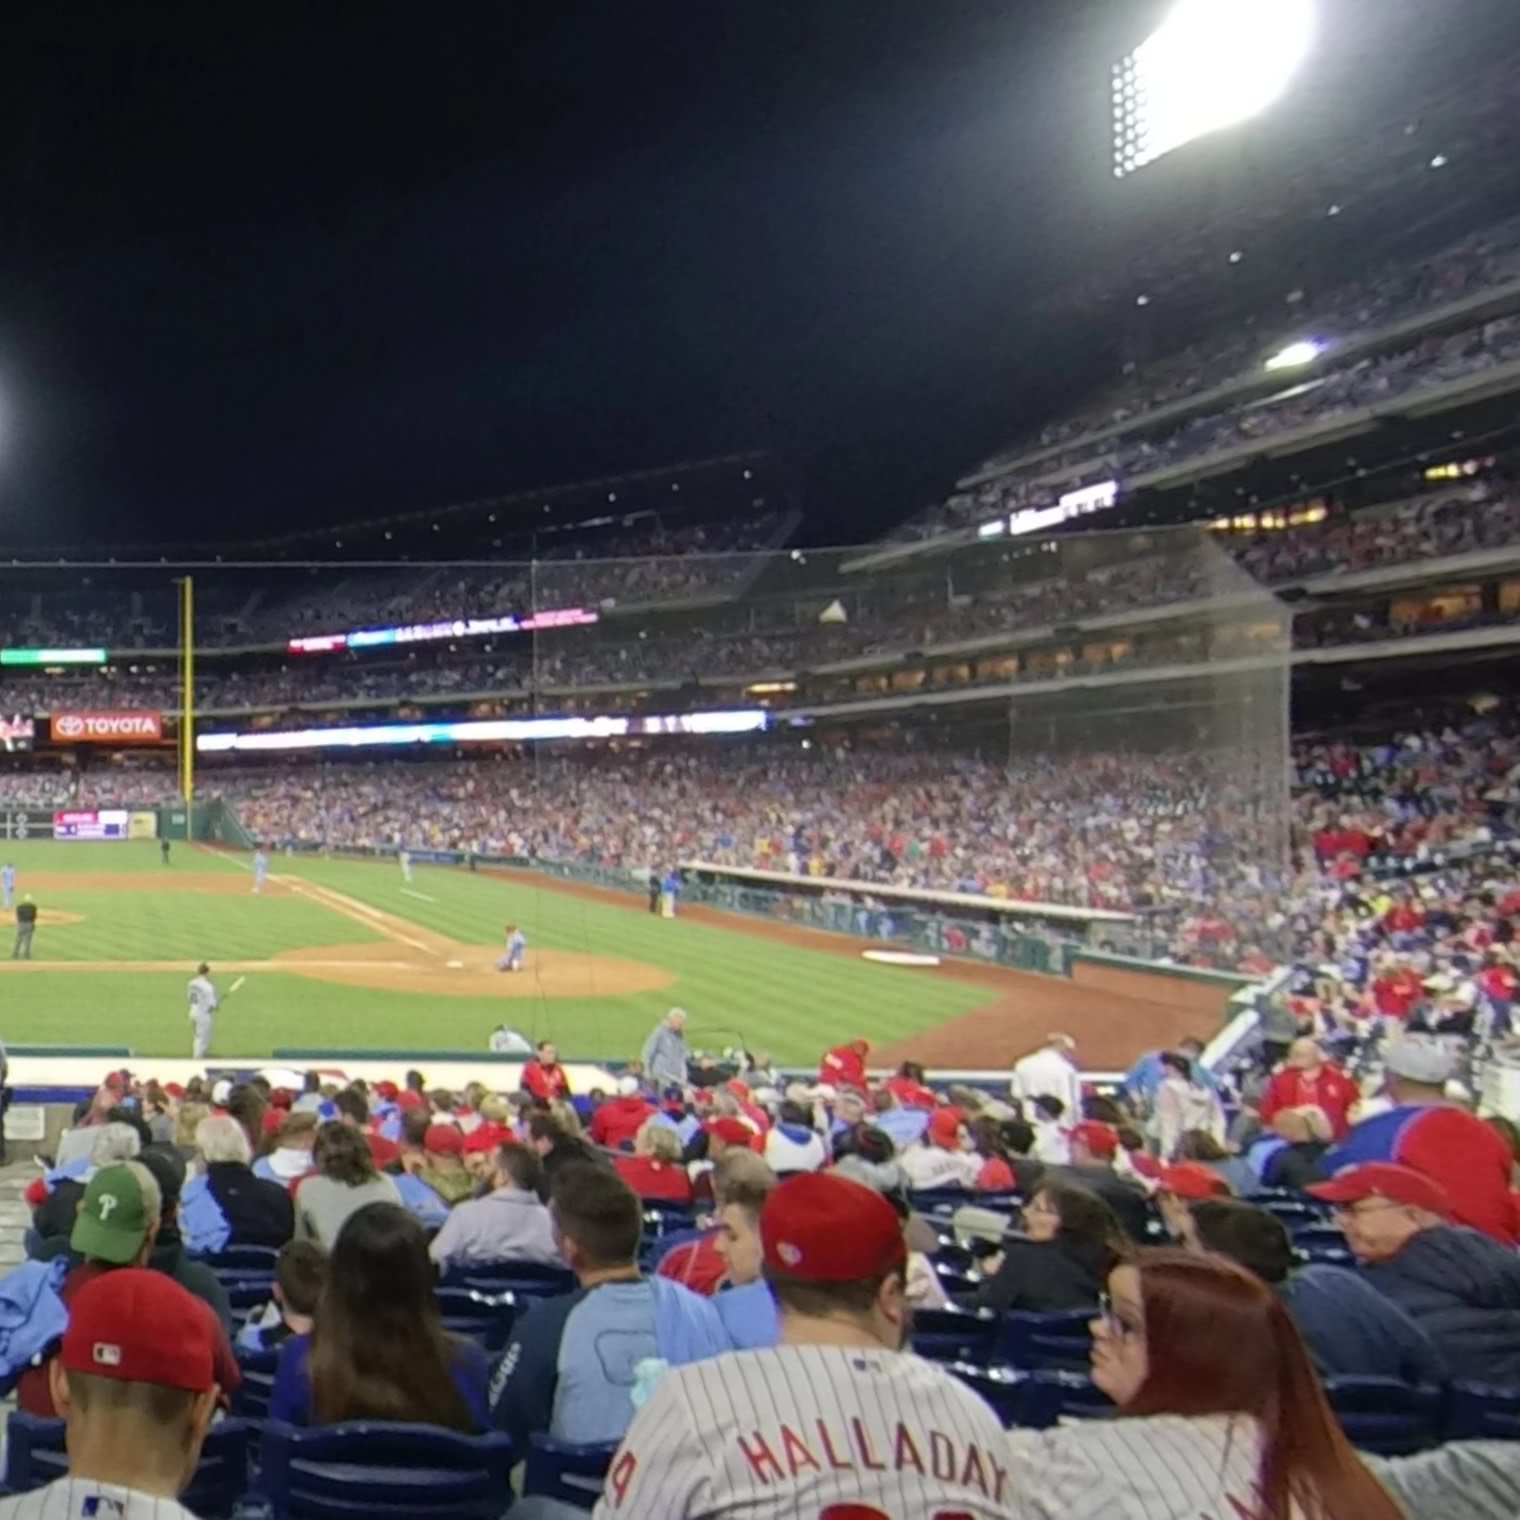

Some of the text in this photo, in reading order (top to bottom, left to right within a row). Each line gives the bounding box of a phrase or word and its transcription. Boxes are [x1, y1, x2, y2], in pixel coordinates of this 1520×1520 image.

[85, 717, 156, 735] TOYOTA
[98, 1193, 118, 1220] P
[736, 1415, 1010, 1504] HALLADAY
